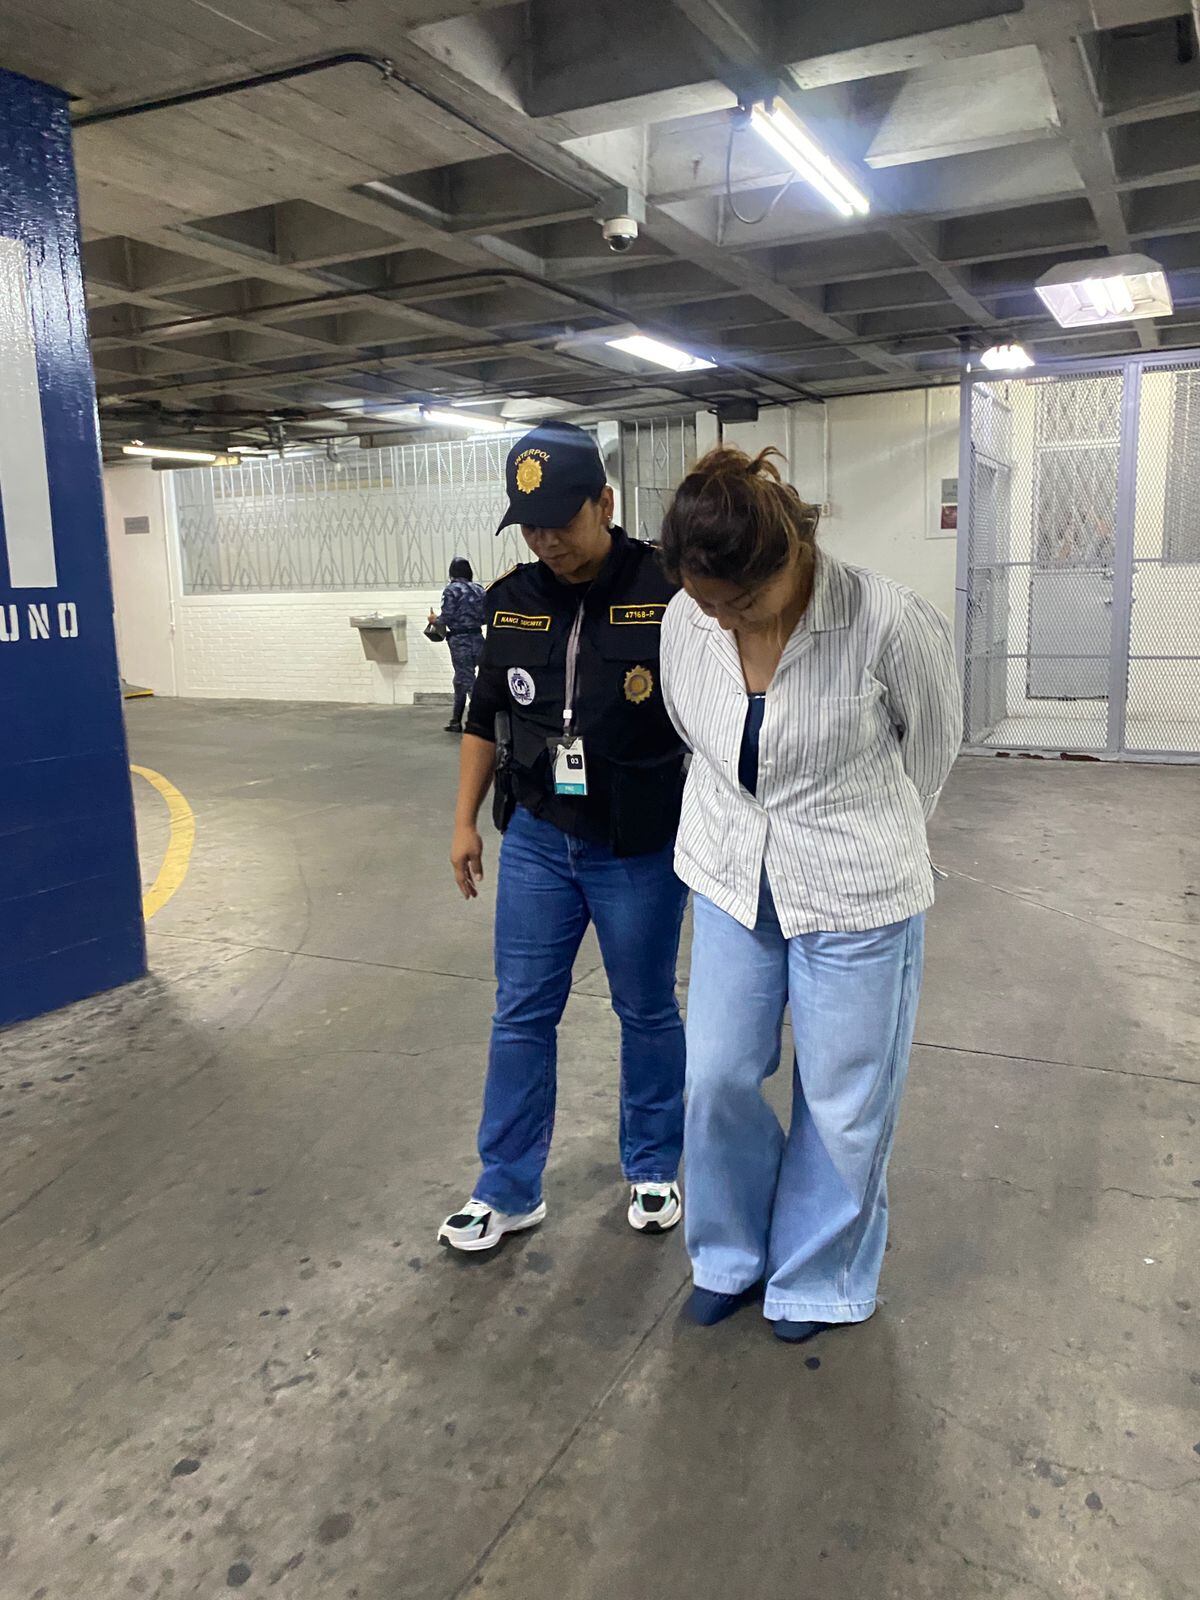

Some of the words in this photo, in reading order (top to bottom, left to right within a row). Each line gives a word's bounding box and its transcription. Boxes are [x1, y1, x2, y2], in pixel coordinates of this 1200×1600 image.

[514, 448, 550, 466] INTERPOL
[0, 602, 78, 642] UNO
[624, 610, 655, 619] 47168-P
